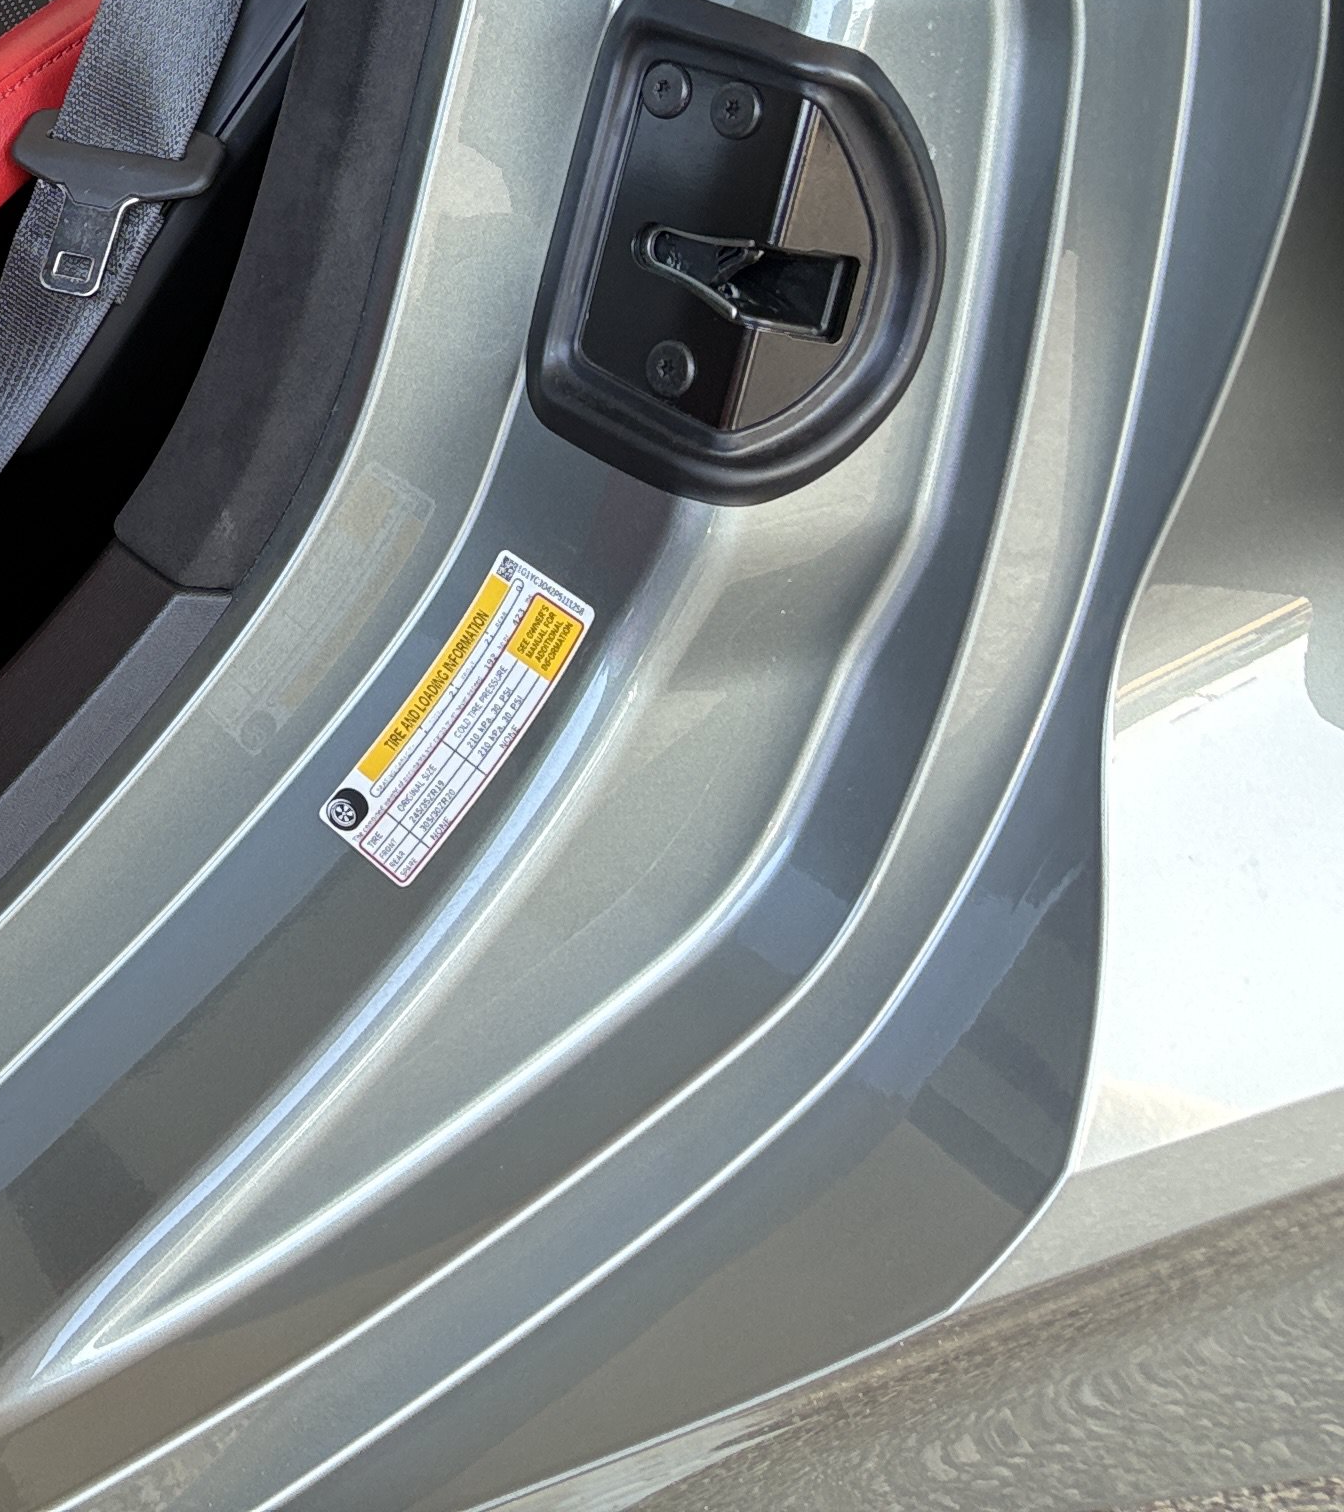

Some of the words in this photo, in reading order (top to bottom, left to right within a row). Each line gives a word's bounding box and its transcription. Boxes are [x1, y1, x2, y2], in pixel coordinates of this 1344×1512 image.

[517, 636, 530, 654] SEE
[525, 604, 549, 639] OWNER'S
[525, 627, 546, 658] MANUAL
[543, 611, 556, 627] FOR
[534, 619, 563, 662] ADDITIONAL
[540, 621, 573, 671] INFORMATION
[383, 727, 406, 751] TIRE
[399, 708, 420, 731] AND
[414, 669, 449, 712] LOADING
[442, 609, 489, 673] INFORMATION
[453, 717, 471, 738] COLD
[467, 701, 482, 718] TIRE
[478, 665, 507, 702] PRESSURE
[466, 733, 479, 748] 210
[490, 703, 500, 714] 30
[499, 686, 512, 701] PSI
[477, 741, 491, 756] 210
[501, 711, 511, 722] 30
[510, 694, 523, 710] PSI
[498, 724, 519, 749] NONE
[396, 779, 424, 812] ORIGINAL
[421, 763, 436, 781] SIZE
[409, 779, 445, 823] 245/35ZR19
[419, 788, 455, 831] 305/30ZR20
[367, 831, 382, 848] TIRE
[379, 838, 396, 859] FRONT
[430, 816, 450, 840] NONE
[389, 850, 404, 868] REAR
[400, 856, 417, 876] SPARE
